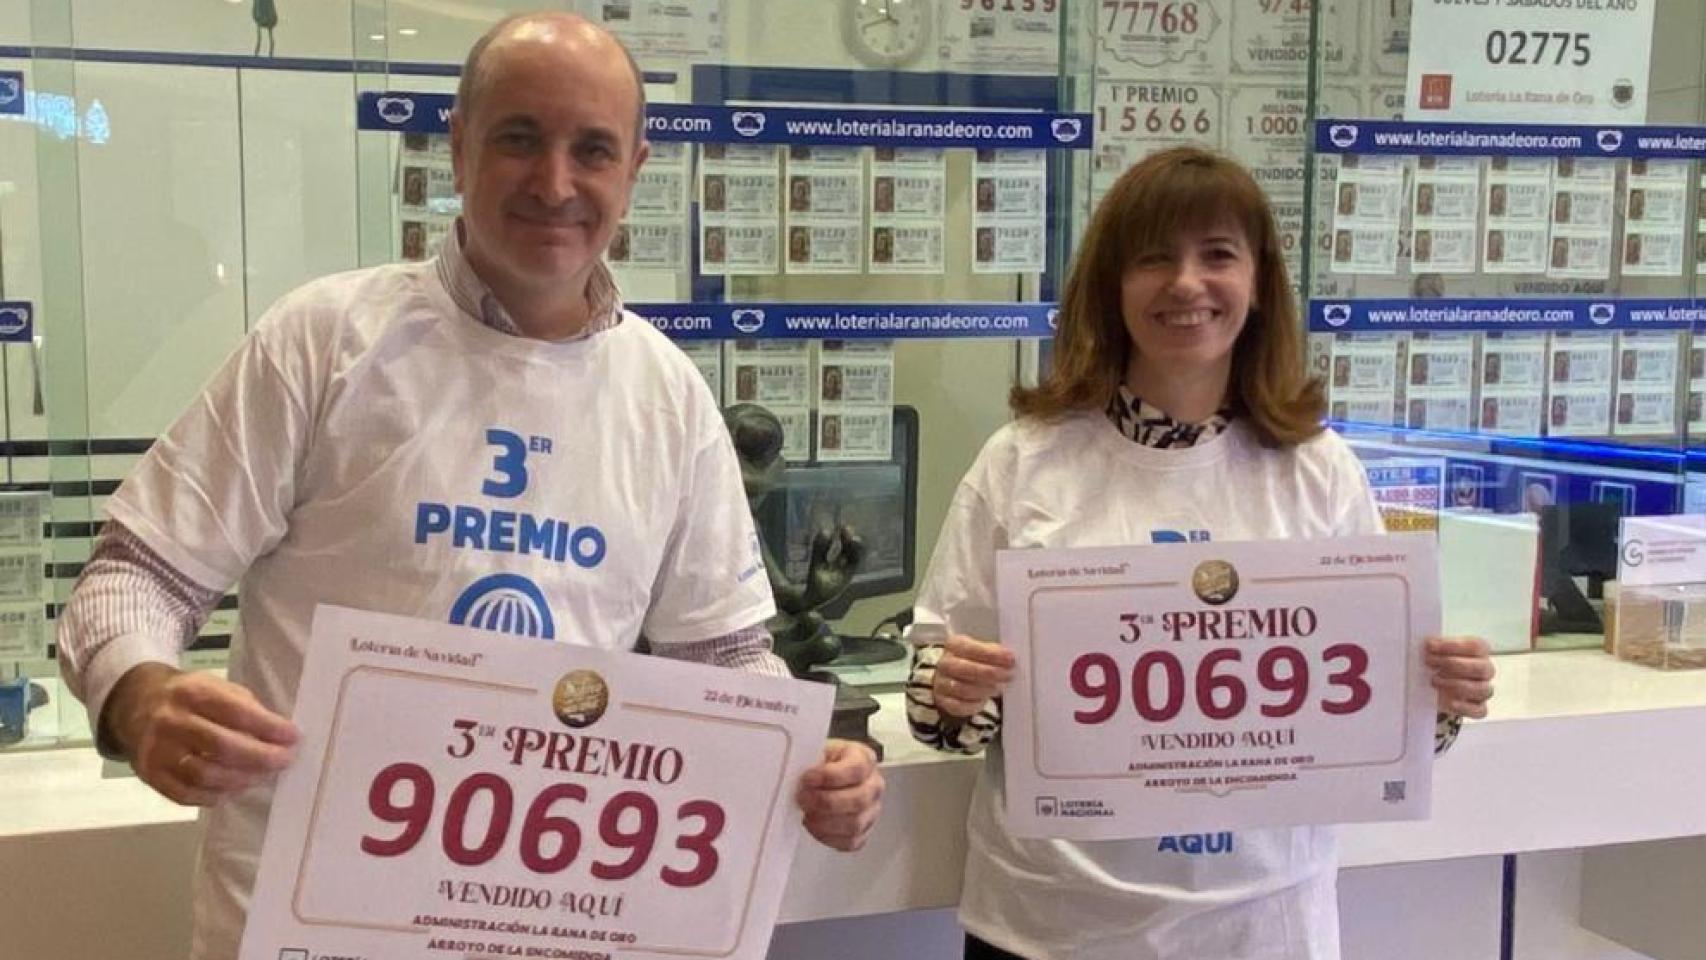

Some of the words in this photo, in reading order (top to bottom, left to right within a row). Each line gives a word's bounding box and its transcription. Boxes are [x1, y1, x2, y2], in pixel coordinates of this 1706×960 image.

[1102, 1, 1199, 34] 77768
[1486, 29, 1592, 67] 02775
[1126, 86, 1199, 104] PREMIO
[786, 119, 1033, 140] www.loterialaranadeoro.com
[1098, 106, 1210, 134] 15666
[1374, 129, 1582, 150] www.loterialaranadeoro.com
[785, 311, 1029, 330] www.loterialaranadeoro.com
[1367, 305, 1574, 323] www.loterialaranadeoro.com
[414, 502, 608, 568] PREMIO
[1162, 606, 1317, 642] PREMIO
[1070, 643, 1371, 725] 90693
[502, 726, 684, 784] PREMIO
[1141, 731, 1235, 751] VENDIDO
[1225, 759, 1239, 768] LA
[1274, 757, 1288, 765] DE
[1290, 755, 1315, 764] ORO
[1193, 778, 1207, 786] DE
[1209, 777, 1222, 786] LA
[360, 763, 726, 887] 90693
[438, 880, 552, 910] VENDIDO
[413, 914, 530, 934] ADMINISTRACIÓN
[532, 926, 547, 936] LA
[550, 928, 587, 940] RANA
[590, 932, 607, 942] DE
[609, 933, 637, 944] ORO
[428, 938, 485, 953] ARROYO
[489, 943, 505, 954] DE
[508, 945, 523, 956] LA
